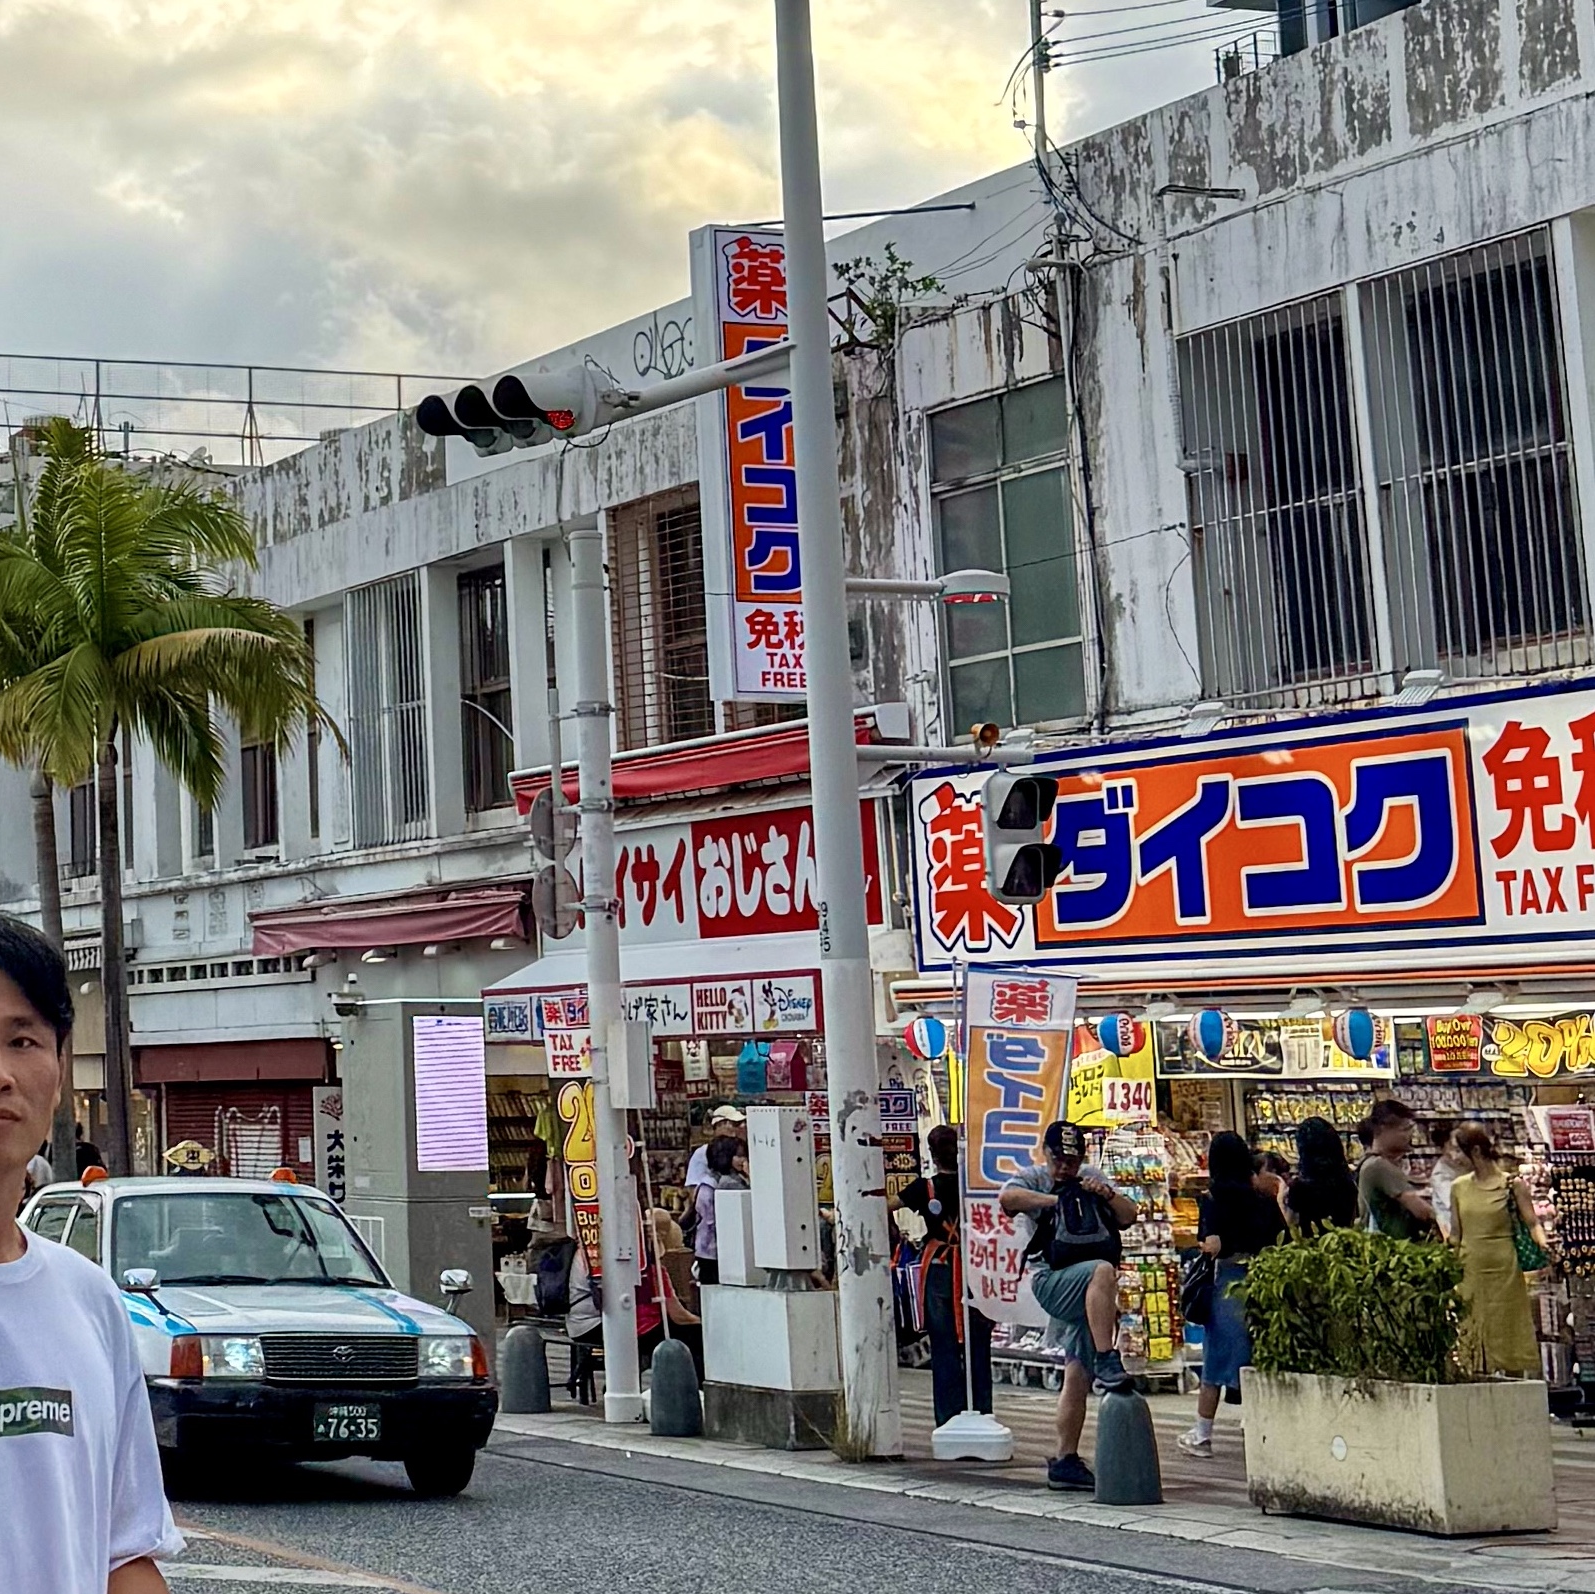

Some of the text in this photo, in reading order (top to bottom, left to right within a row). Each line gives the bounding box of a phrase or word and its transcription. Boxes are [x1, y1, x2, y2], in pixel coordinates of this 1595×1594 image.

[1055, 757, 1453, 925] ダイコク
[1495, 865, 1568, 916] TAX
[695, 987, 727, 1008] HELLO
[697, 1010, 727, 1031] KITTY
[548, 1033, 574, 1051] TAX
[551, 1054, 582, 1072] FREE
[1108, 1081, 1152, 1111] 1340
[577, 1210, 598, 1227] Bu
